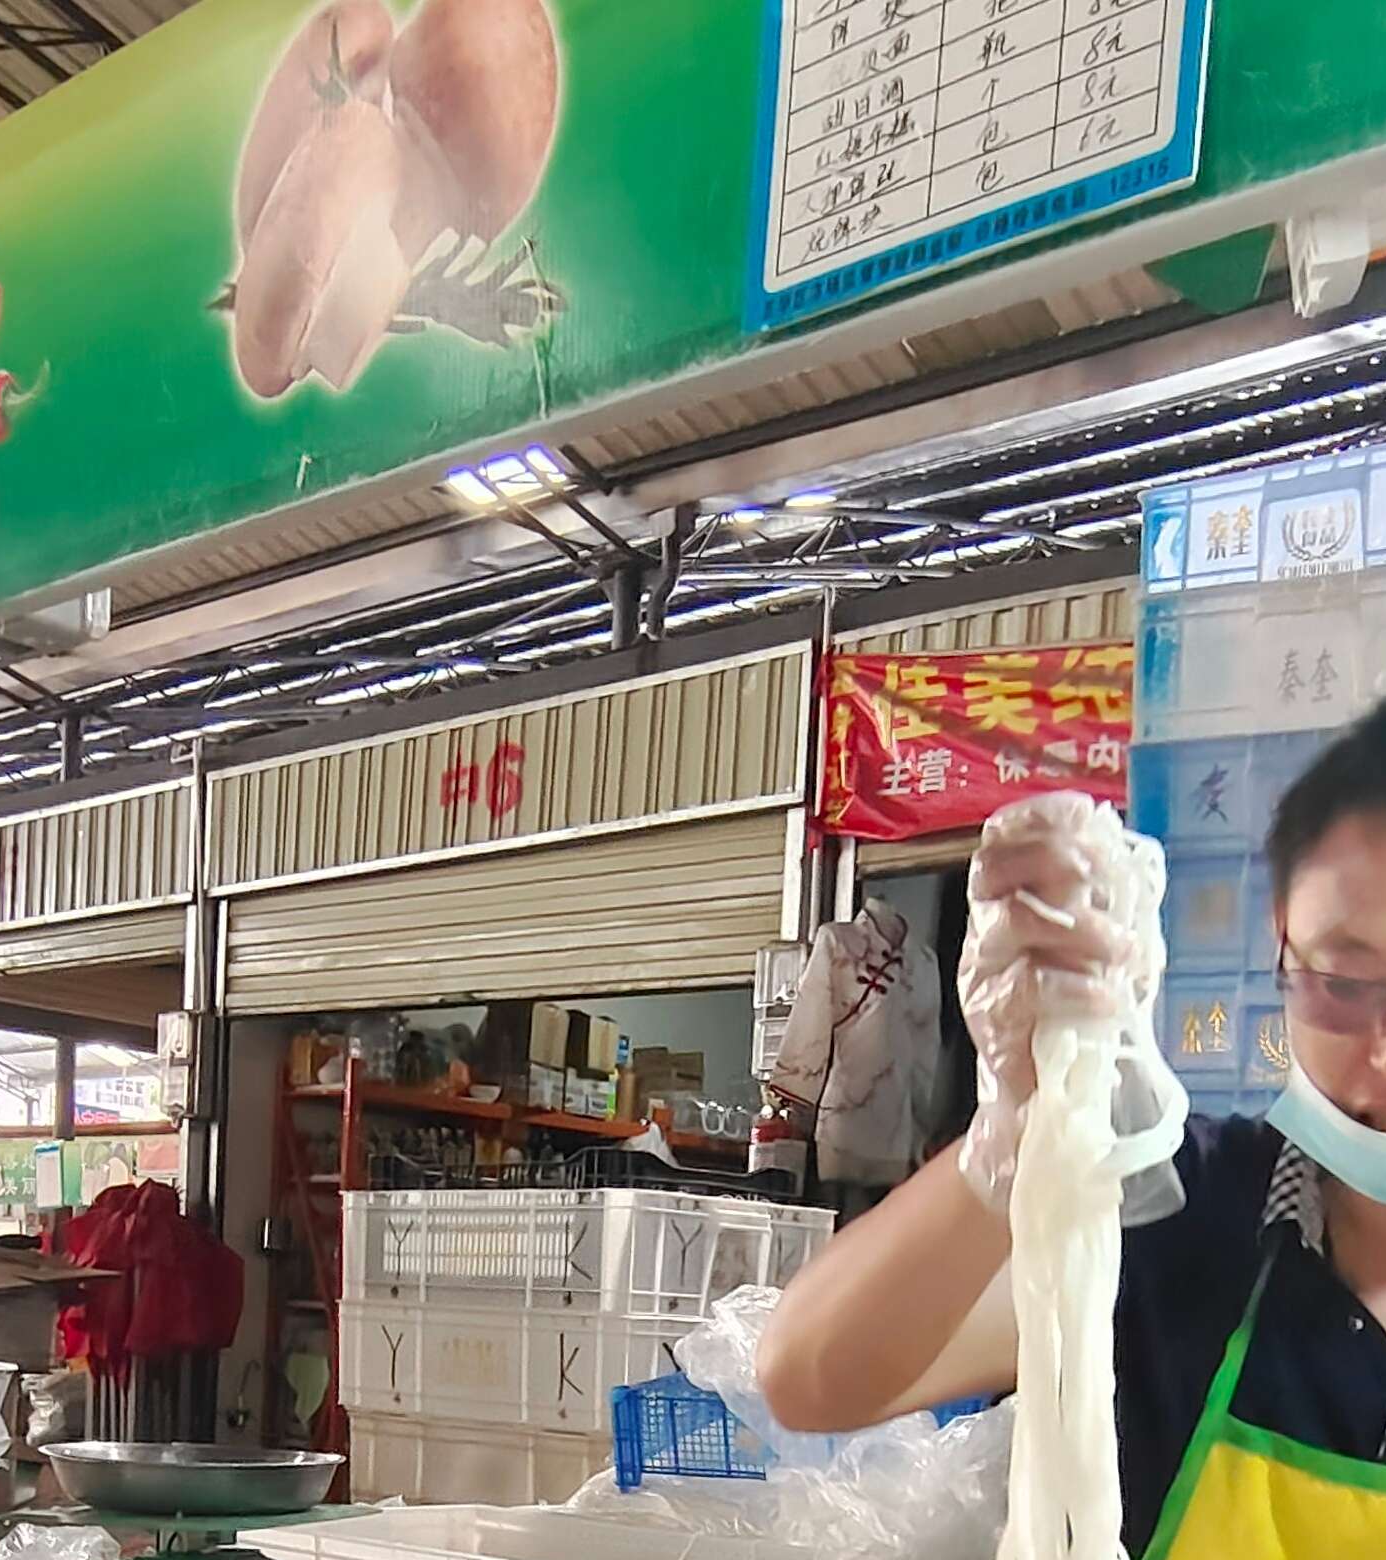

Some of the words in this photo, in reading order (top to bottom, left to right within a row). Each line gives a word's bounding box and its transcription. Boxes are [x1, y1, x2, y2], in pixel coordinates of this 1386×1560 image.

[671, 1218, 703, 1287] Y
[382, 1324, 404, 1388] Y
[558, 1332, 584, 1401] K
